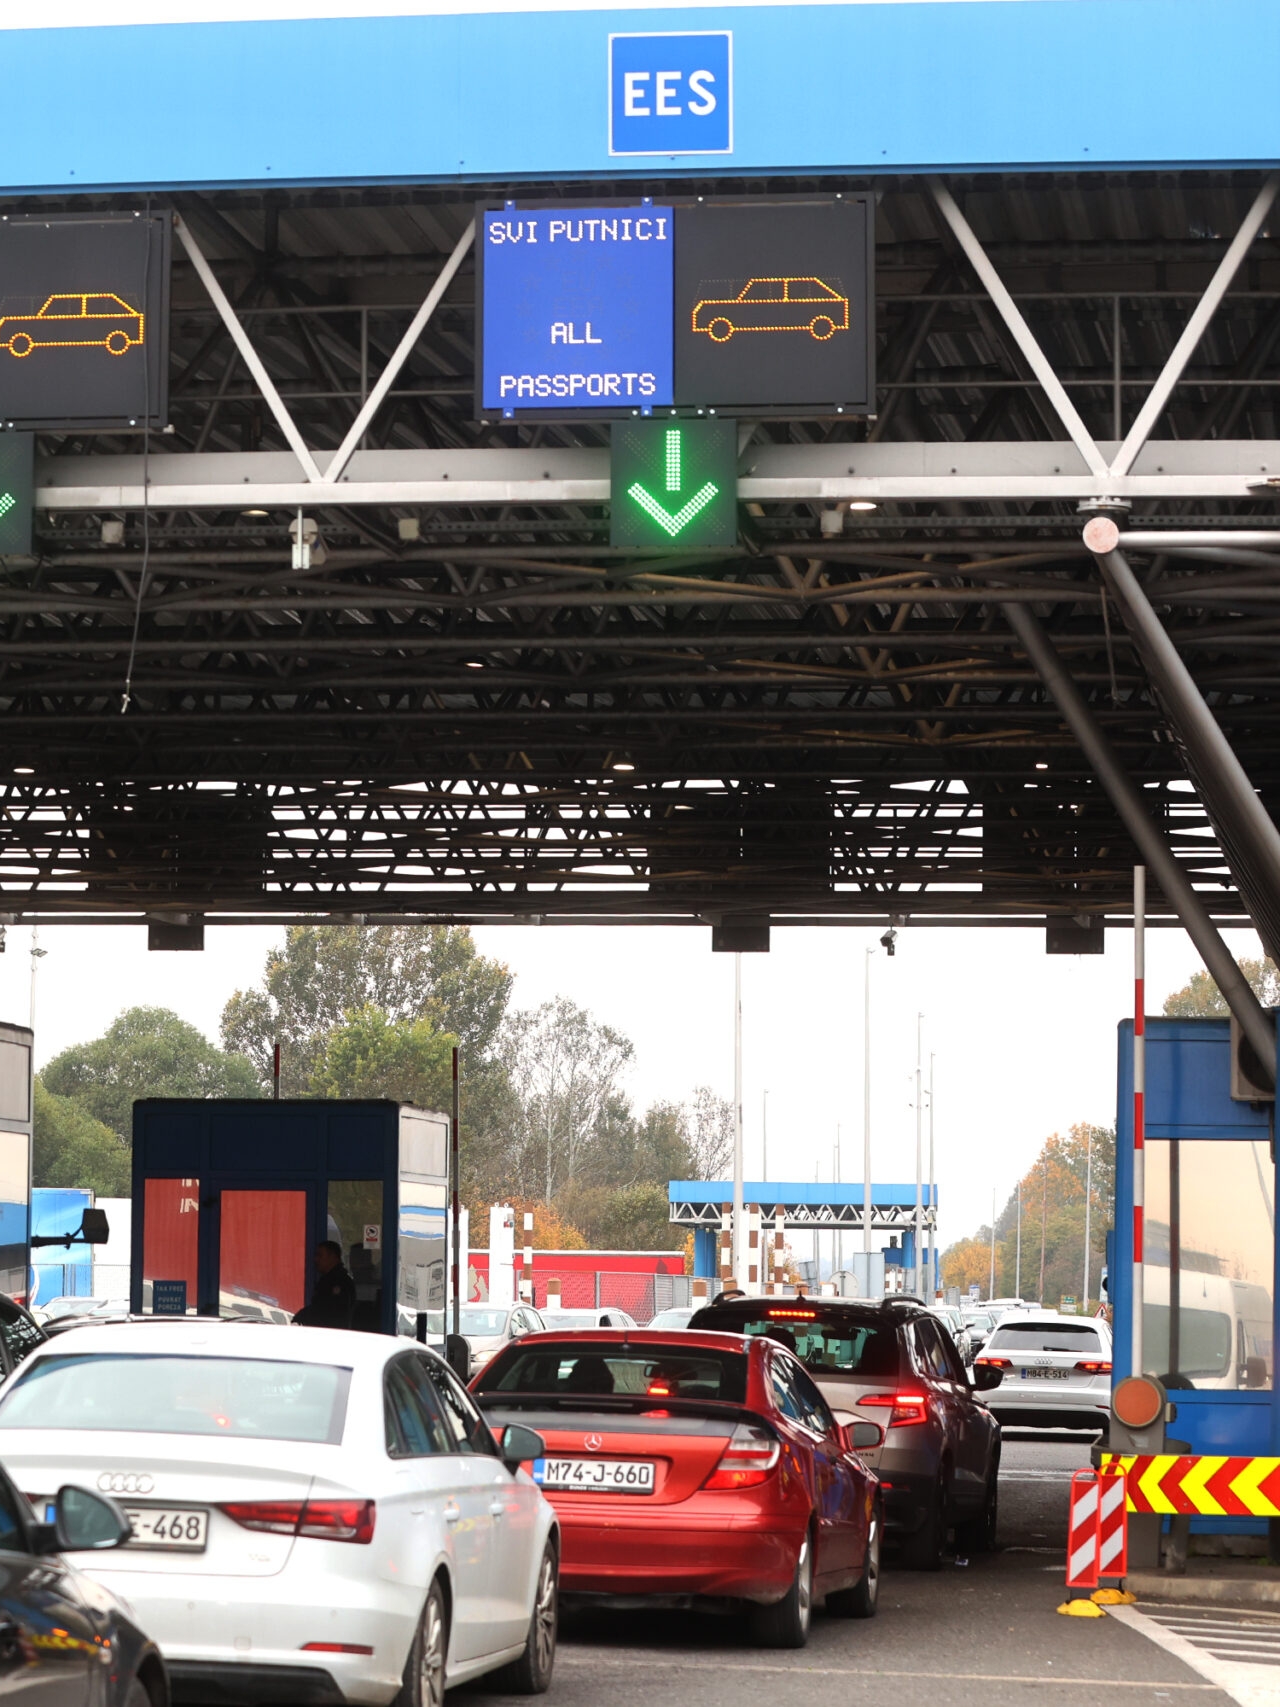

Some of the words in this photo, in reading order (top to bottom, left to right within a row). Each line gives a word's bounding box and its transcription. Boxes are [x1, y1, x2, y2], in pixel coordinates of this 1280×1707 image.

[624, 70, 717, 117] EES
[489, 221, 538, 245] SVI
[549, 217, 668, 243] PUTNICI
[550, 321, 603, 345] ALL
[499, 372, 657, 398] PASSPORTS
[1026, 1369, 1067, 1379] M84-E-514
[546, 1462, 650, 1485] M74-J-660
